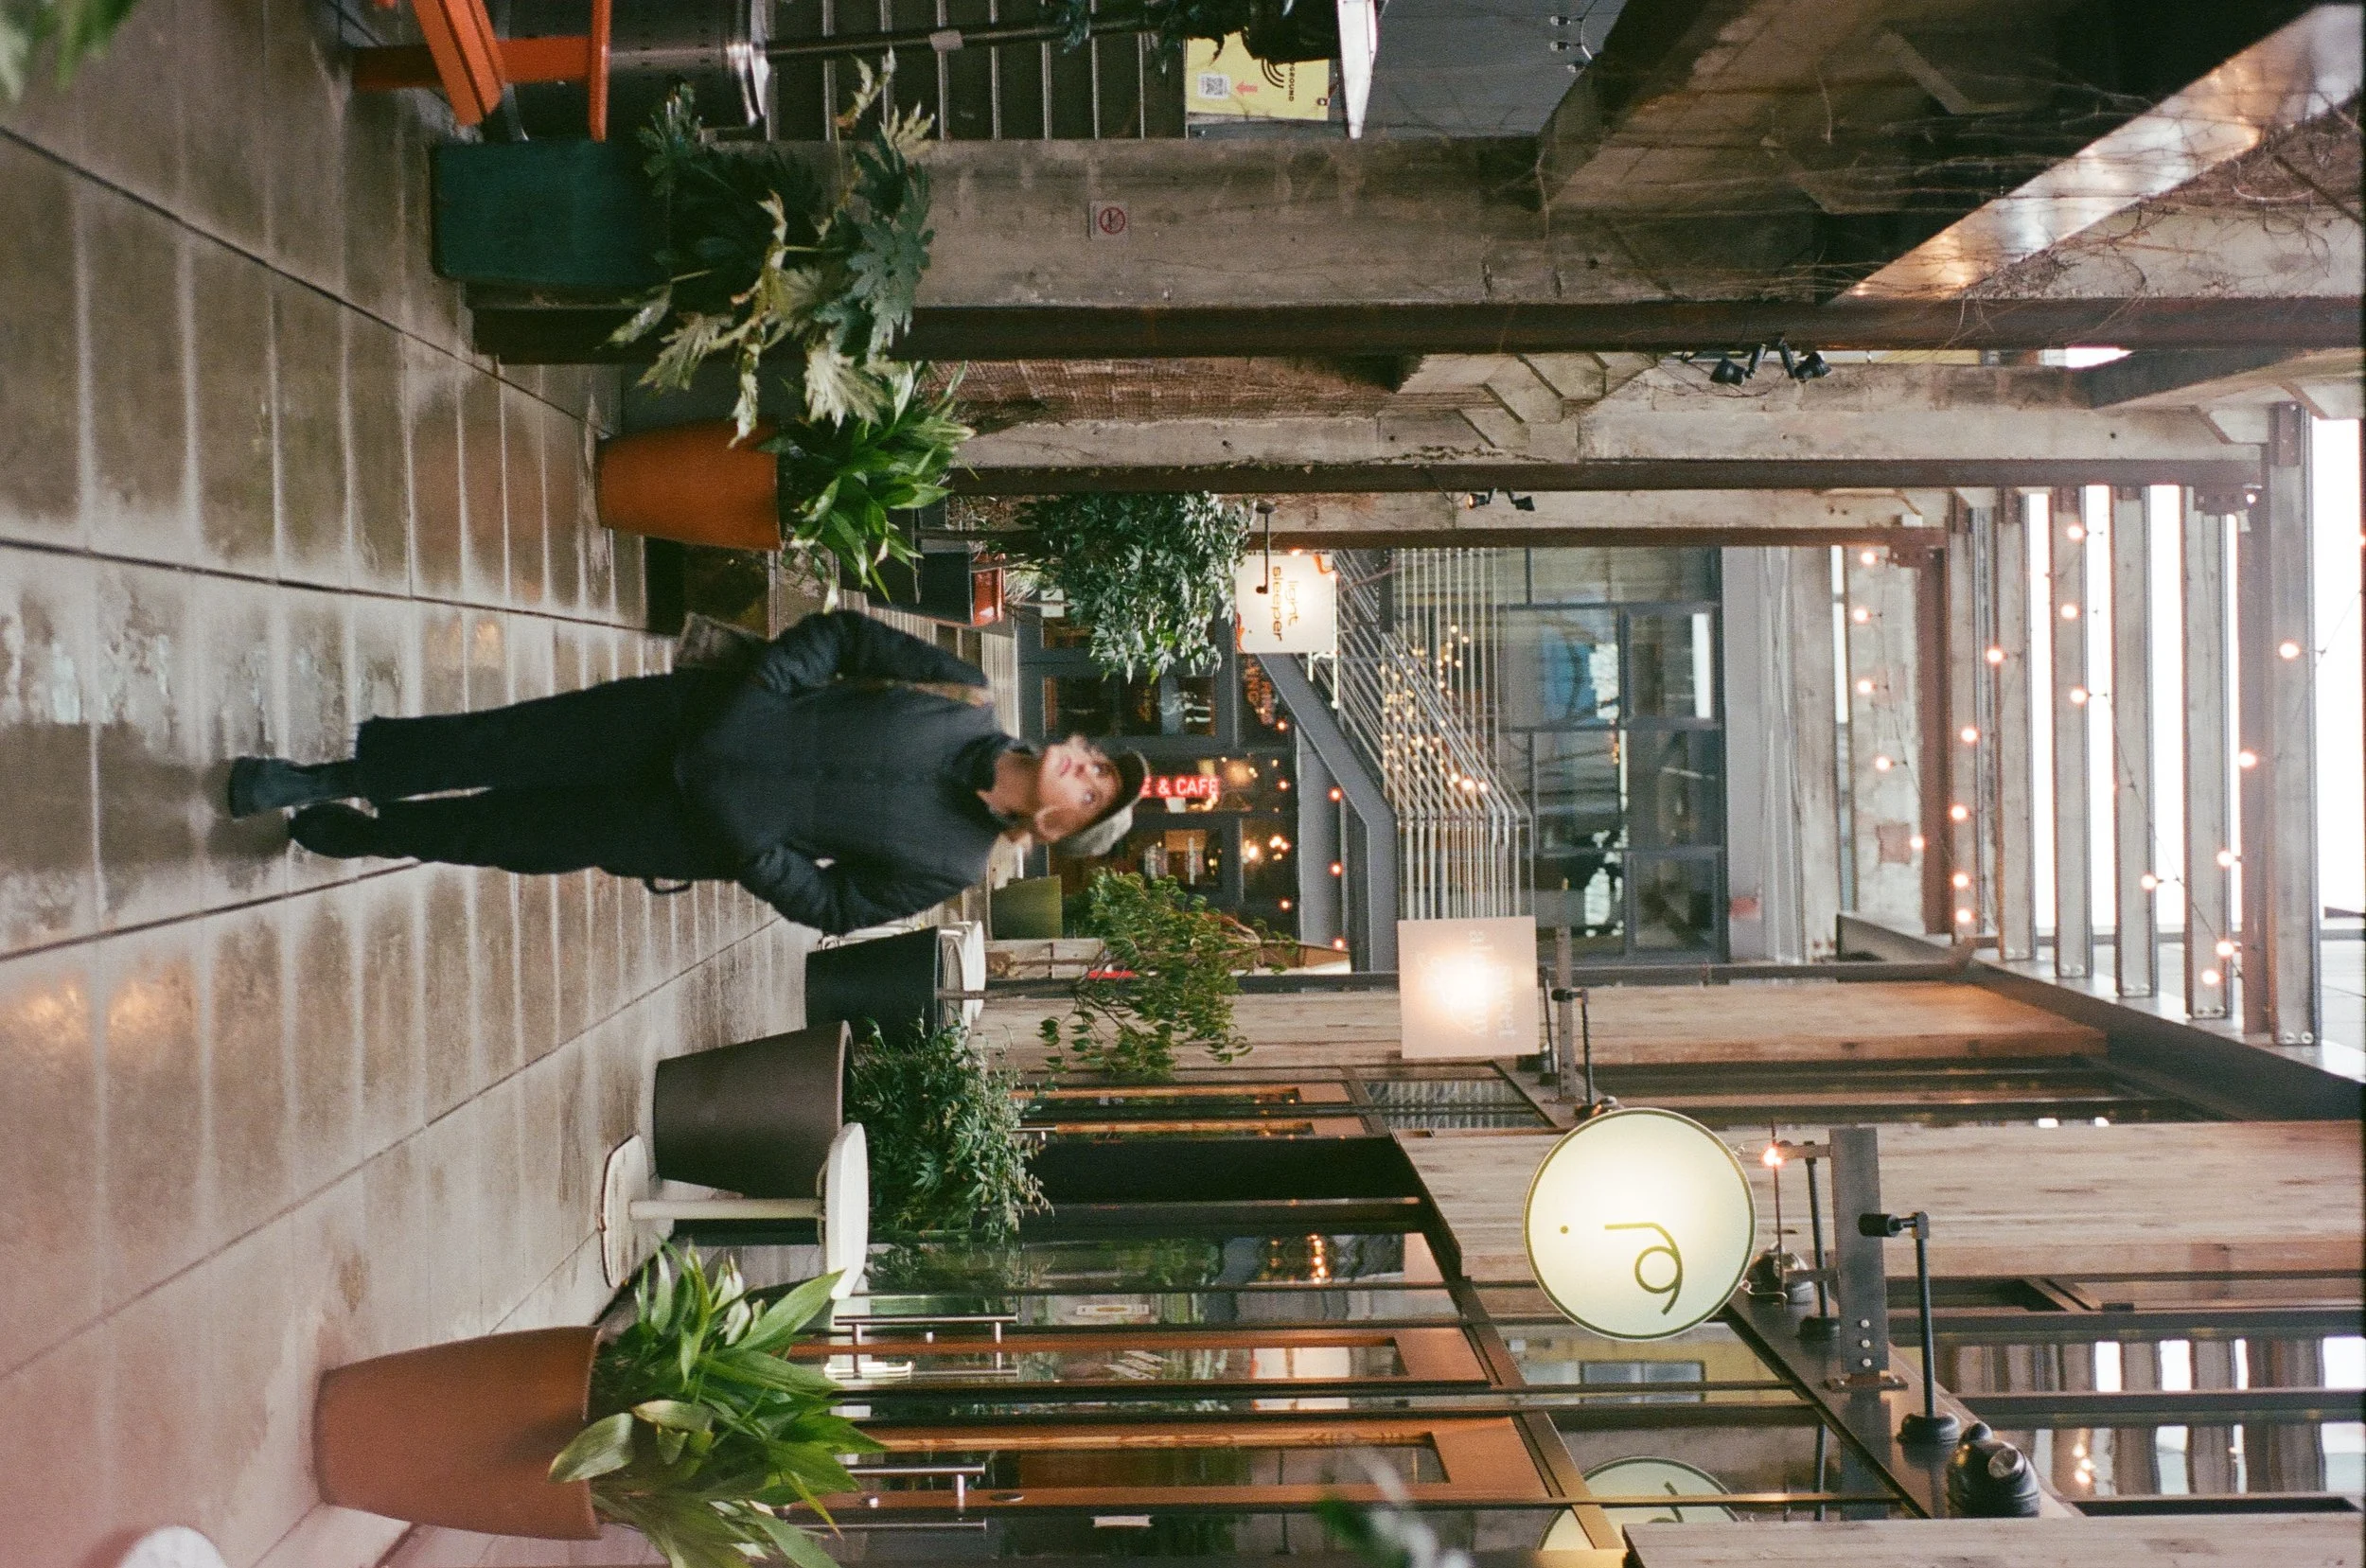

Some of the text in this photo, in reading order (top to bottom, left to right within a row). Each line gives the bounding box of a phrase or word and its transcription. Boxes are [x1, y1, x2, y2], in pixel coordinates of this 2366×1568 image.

[1271, 566, 1283, 642] sleeper
[1285, 581, 1298, 625] light
[1157, 778, 1171, 796] &
